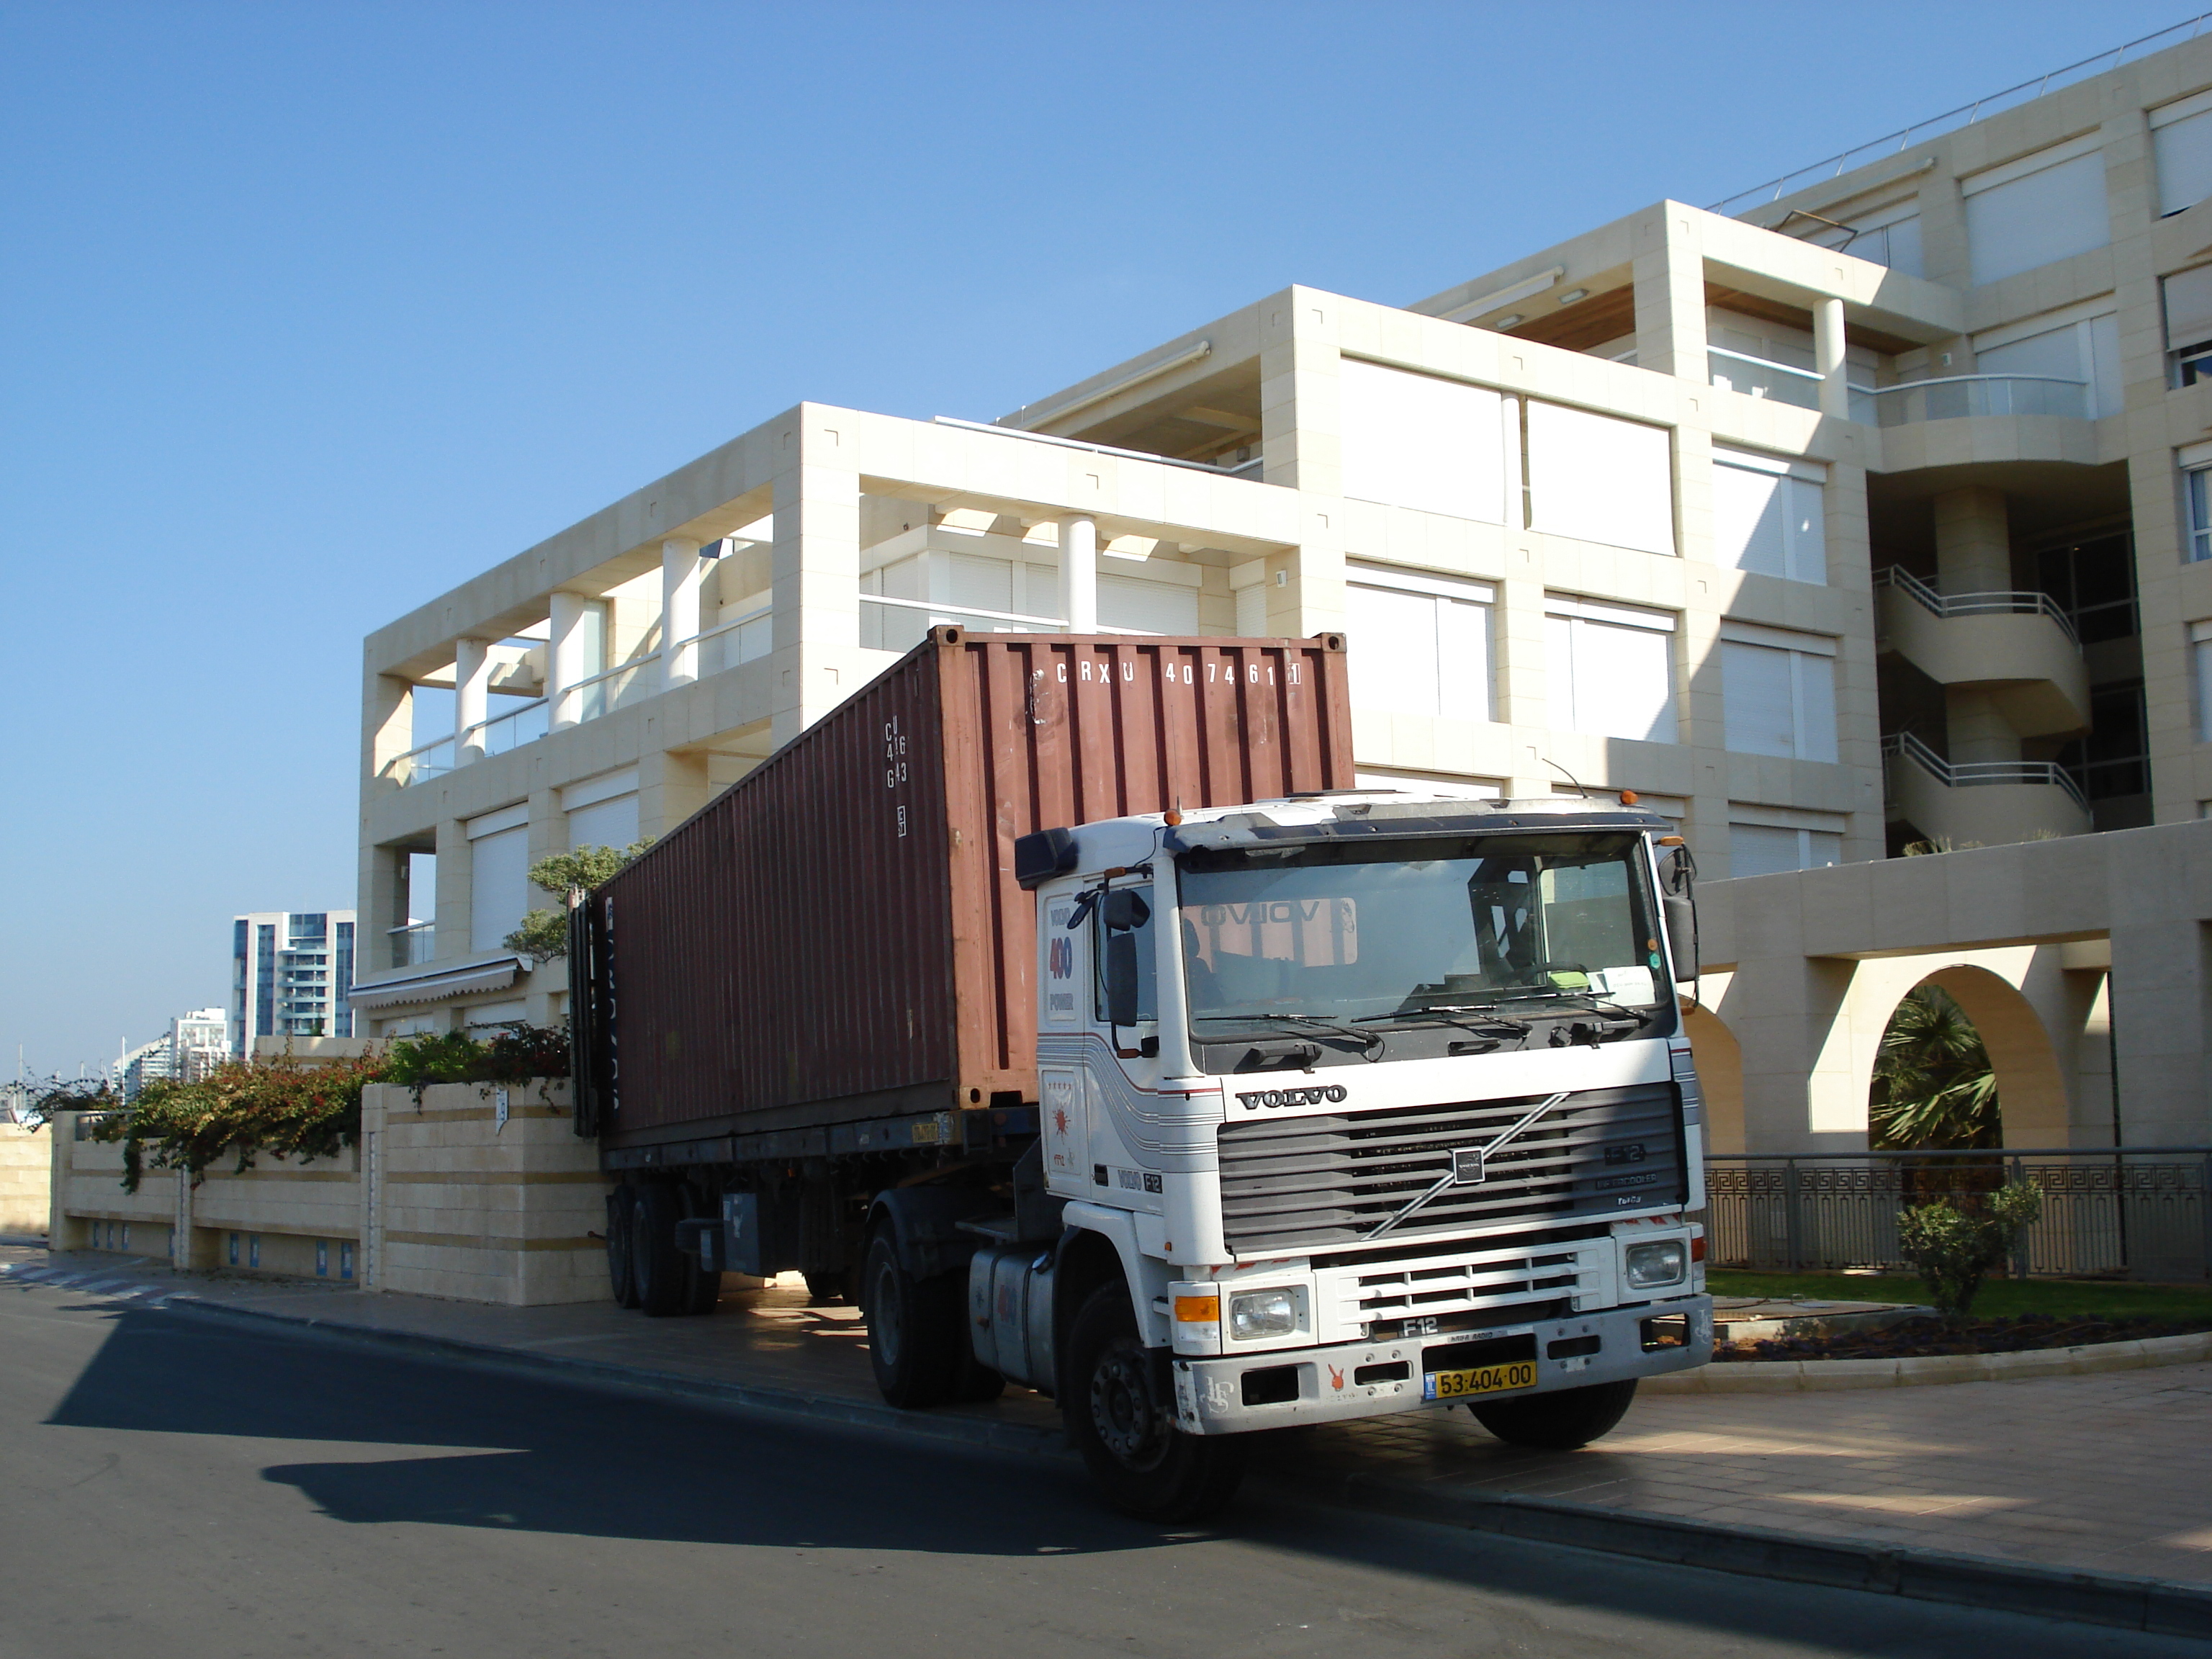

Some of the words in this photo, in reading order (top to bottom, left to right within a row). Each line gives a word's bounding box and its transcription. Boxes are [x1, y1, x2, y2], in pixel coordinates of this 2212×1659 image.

[1056, 661, 1133, 684] CRXU
[1166, 663, 1274, 685] 407461
[1050, 936, 1072, 979] 400
[1050, 993, 1074, 1011] POWER
[1236, 1084, 1347, 1110] VOLVO
[1118, 1168, 1142, 1190] VOLVO
[1145, 1175, 1161, 1193] F12
[1403, 1317, 1438, 1337] F12
